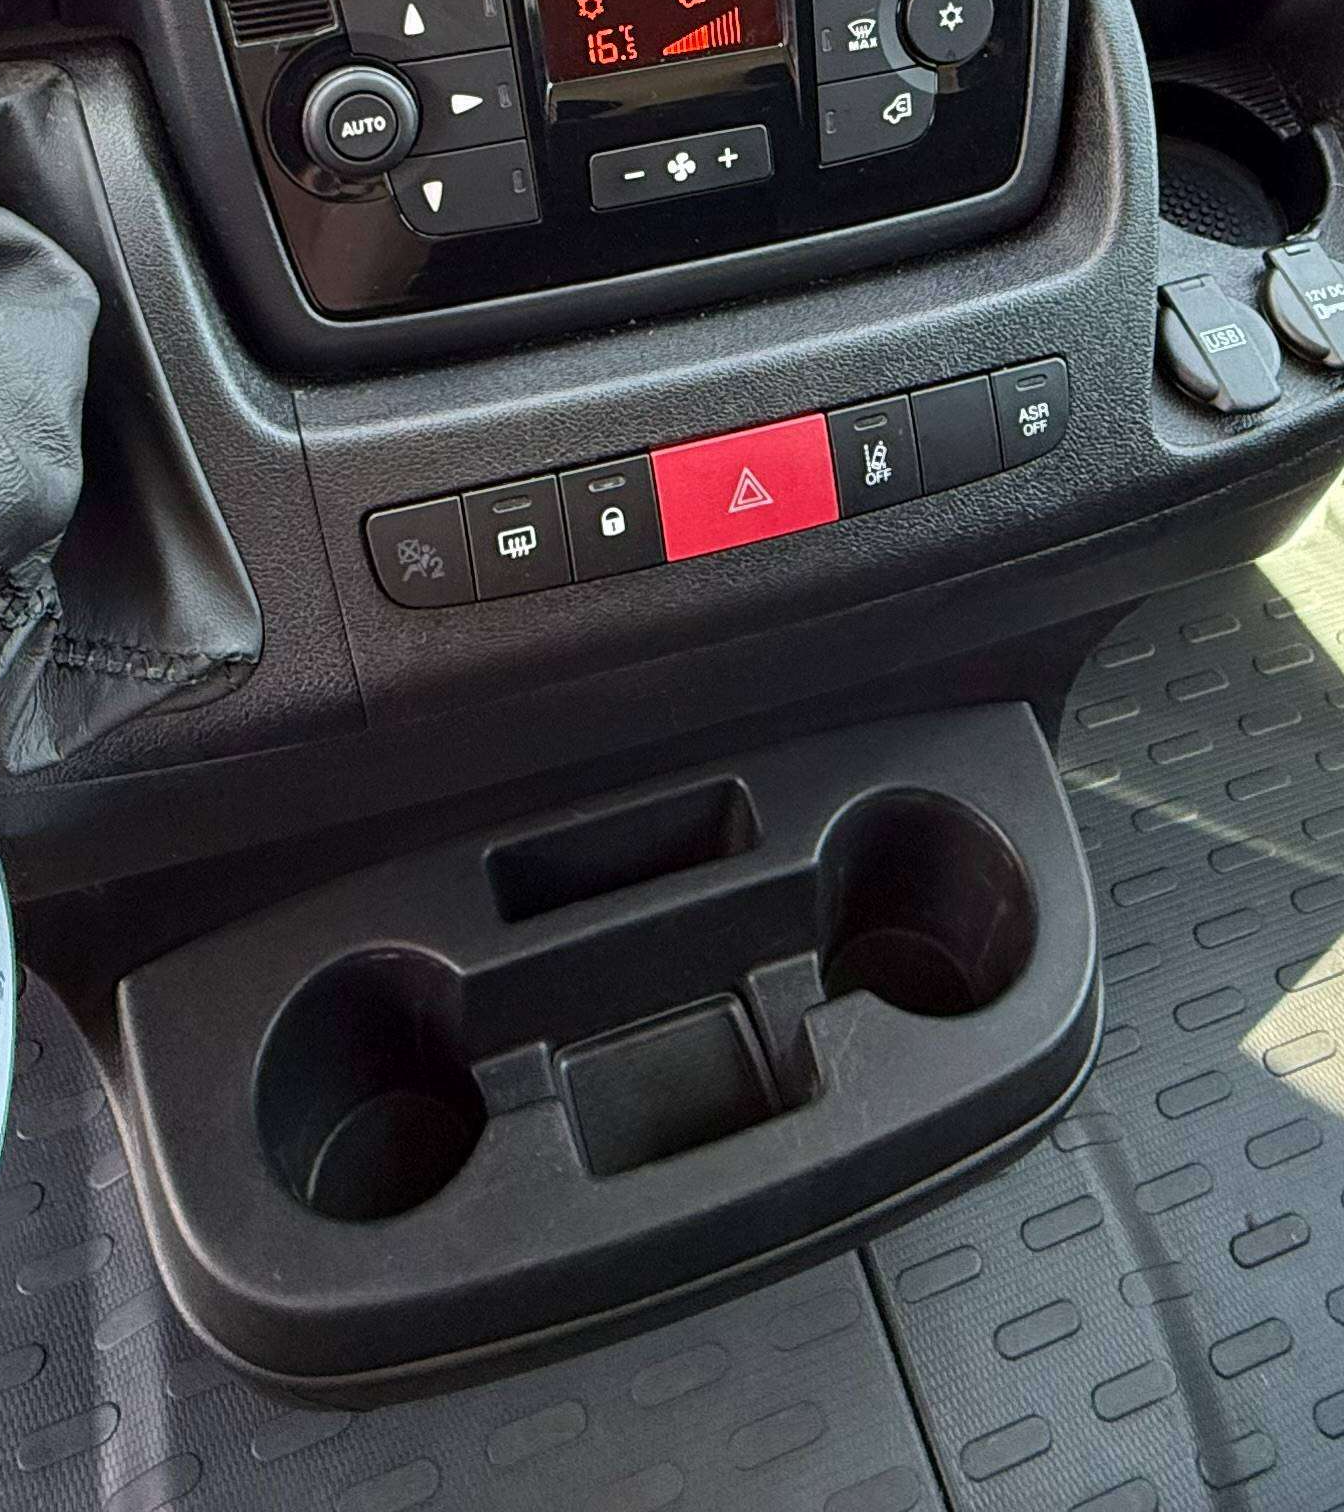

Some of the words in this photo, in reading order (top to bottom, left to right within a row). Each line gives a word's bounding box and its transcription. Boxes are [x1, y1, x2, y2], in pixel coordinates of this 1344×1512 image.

[848, 37, 878, 52] MAX
[341, 115, 387, 139] AUTO
[1305, 286, 1329, 304] 12V
[1206, 329, 1241, 350] USB
[1018, 401, 1051, 424] ASR
[1022, 419, 1048, 437] OFF
[865, 466, 893, 487] OFF
